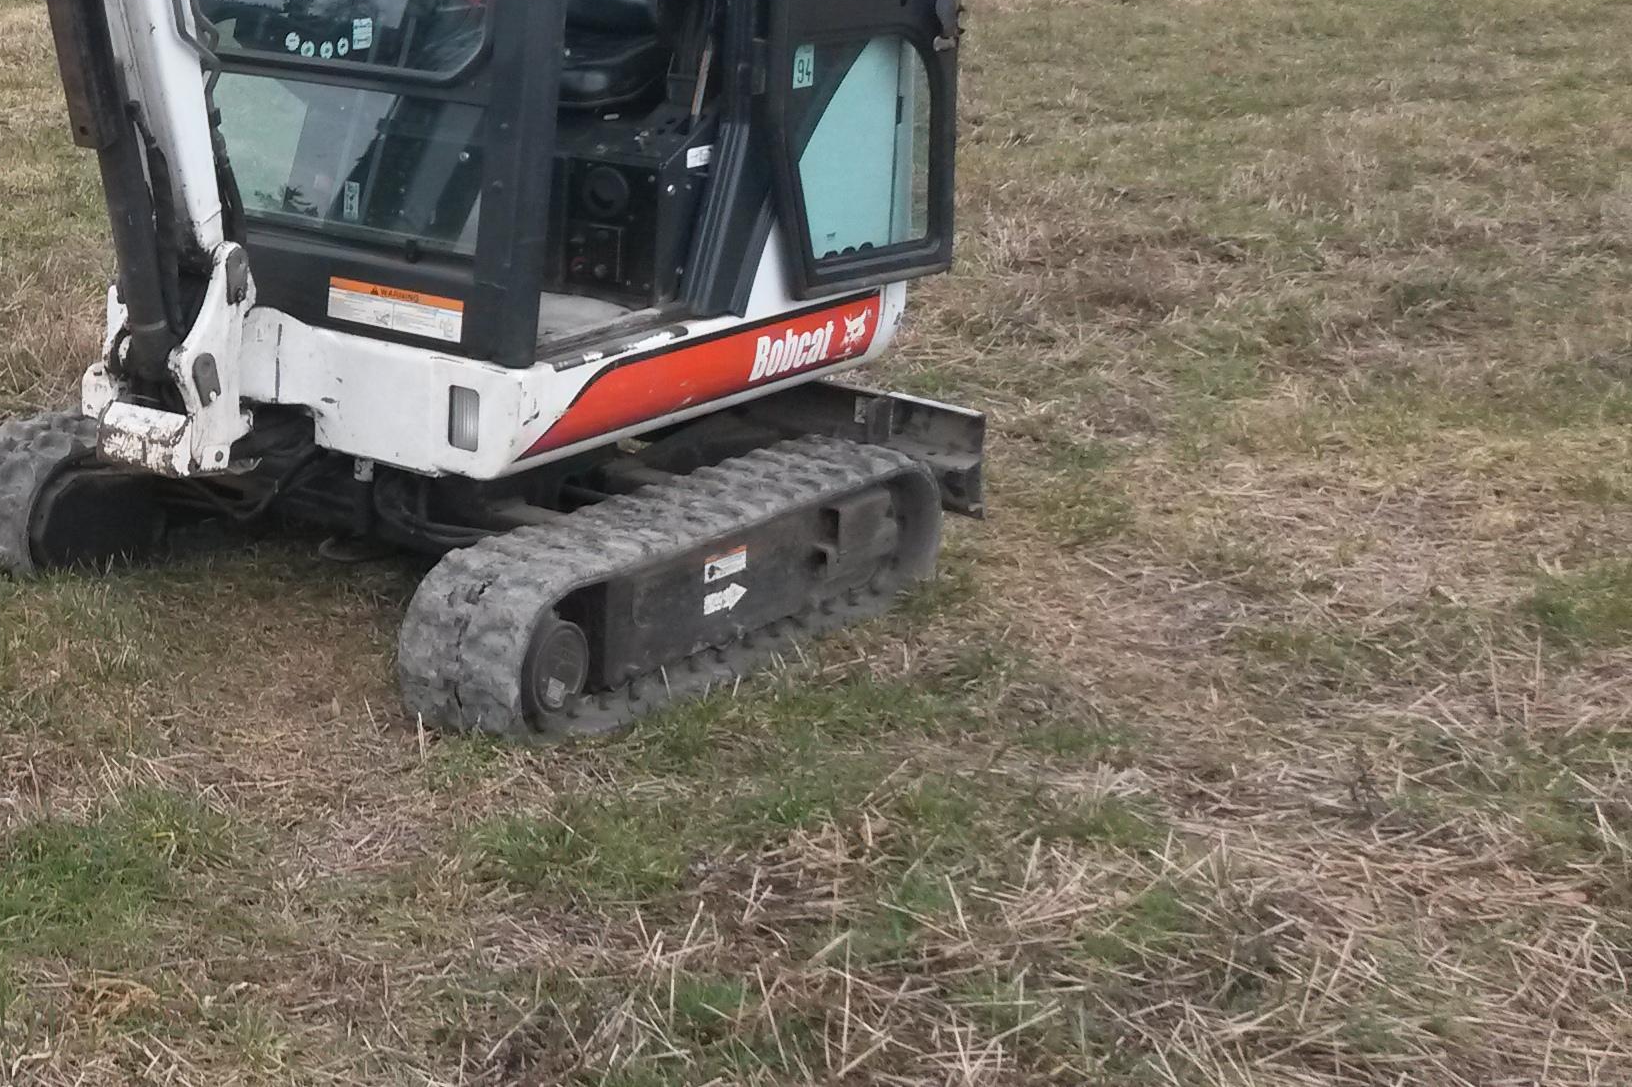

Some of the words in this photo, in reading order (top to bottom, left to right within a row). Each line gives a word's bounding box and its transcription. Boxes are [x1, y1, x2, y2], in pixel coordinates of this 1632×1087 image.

[797, 57, 812, 84] 94
[380, 288, 420, 304] WARNING
[748, 320, 835, 382] Bobcat
